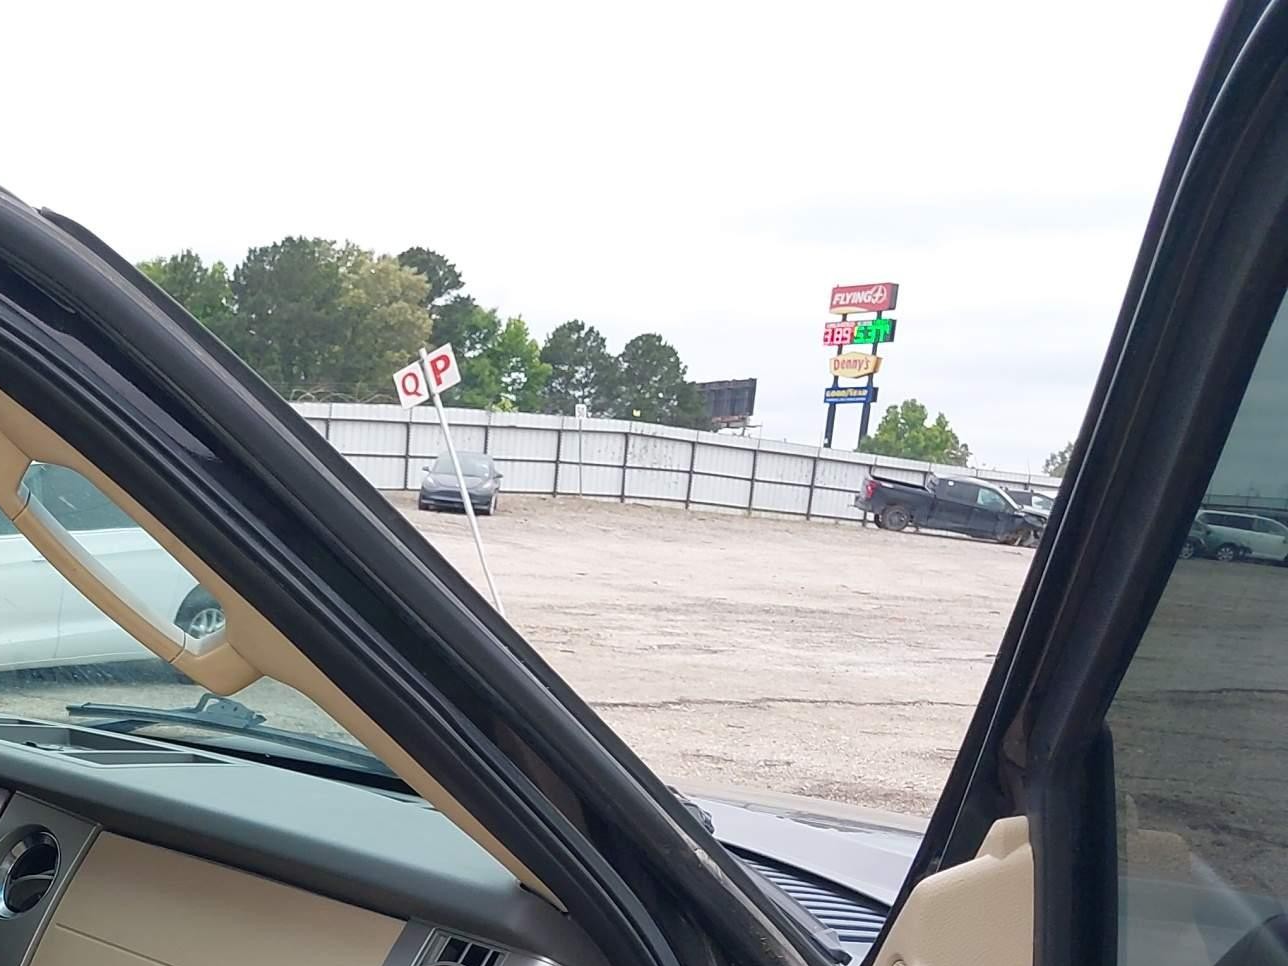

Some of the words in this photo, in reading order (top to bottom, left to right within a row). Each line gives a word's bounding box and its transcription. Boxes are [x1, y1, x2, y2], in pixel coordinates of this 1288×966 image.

[832, 291, 873, 305] FLYING
[430, 354, 451, 386] P
[833, 356, 871, 372] Denny's
[401, 372, 423, 397] Q
